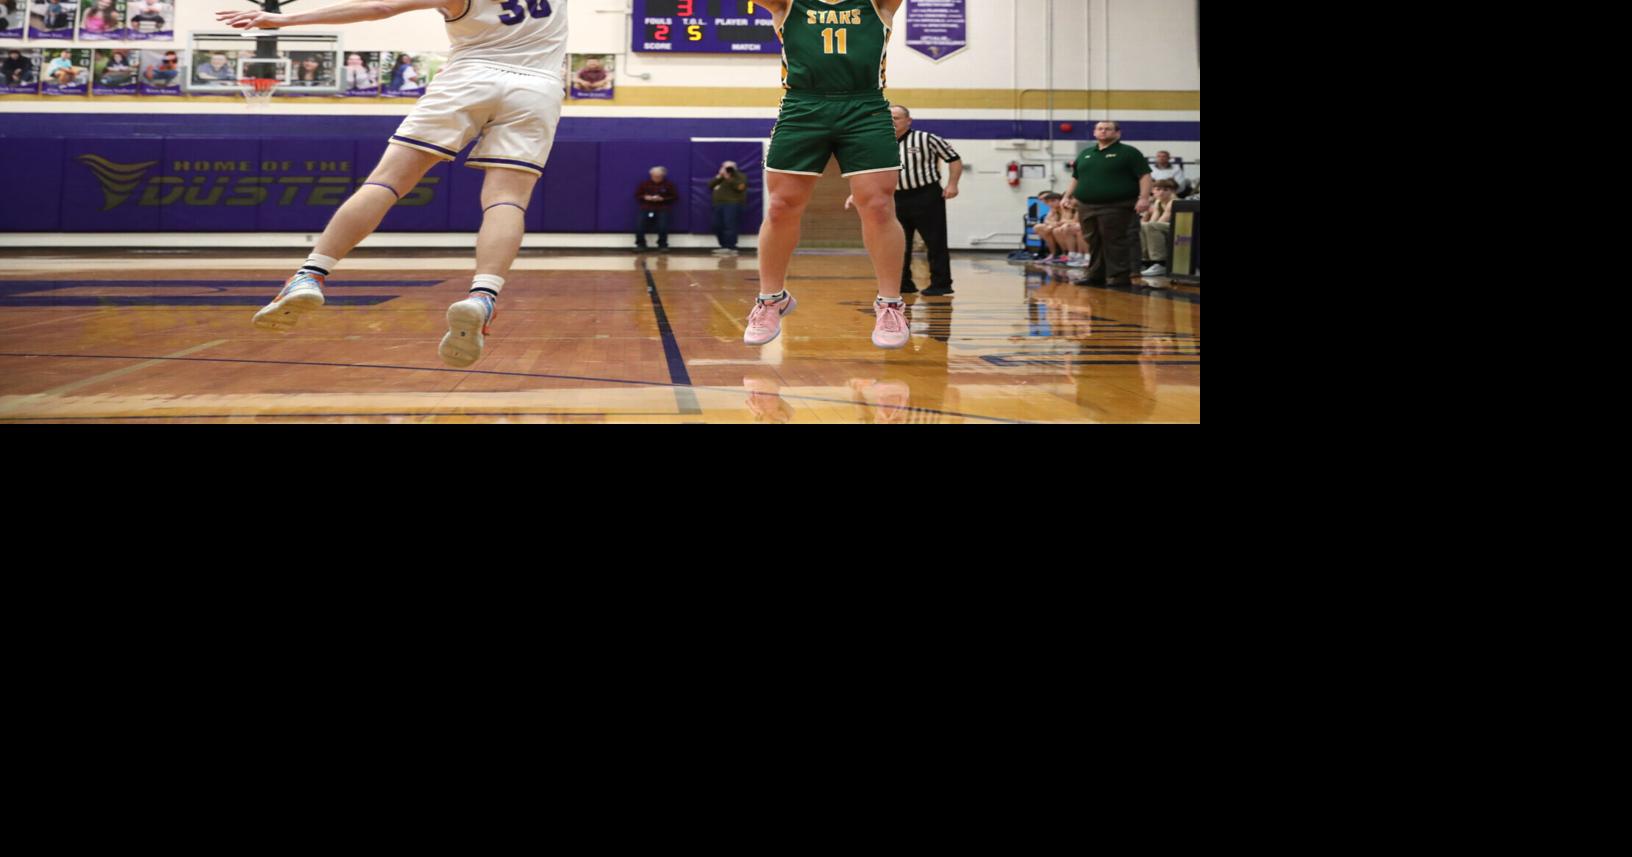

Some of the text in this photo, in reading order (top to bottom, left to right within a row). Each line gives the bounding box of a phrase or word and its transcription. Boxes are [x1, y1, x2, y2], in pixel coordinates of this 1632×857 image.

[644, 17, 673, 25] FOULS
[714, 18, 749, 26] PLAYER
[806, 8, 861, 25] STARS
[654, 24, 670, 41] 2
[687, 25, 702, 41] 5
[643, 42, 672, 50] SCORE
[731, 43, 761, 51] MATCH
[821, 27, 847, 55] 11
[173, 160, 352, 172] HOME OF THE
[138, 176, 441, 206] DUSTES
